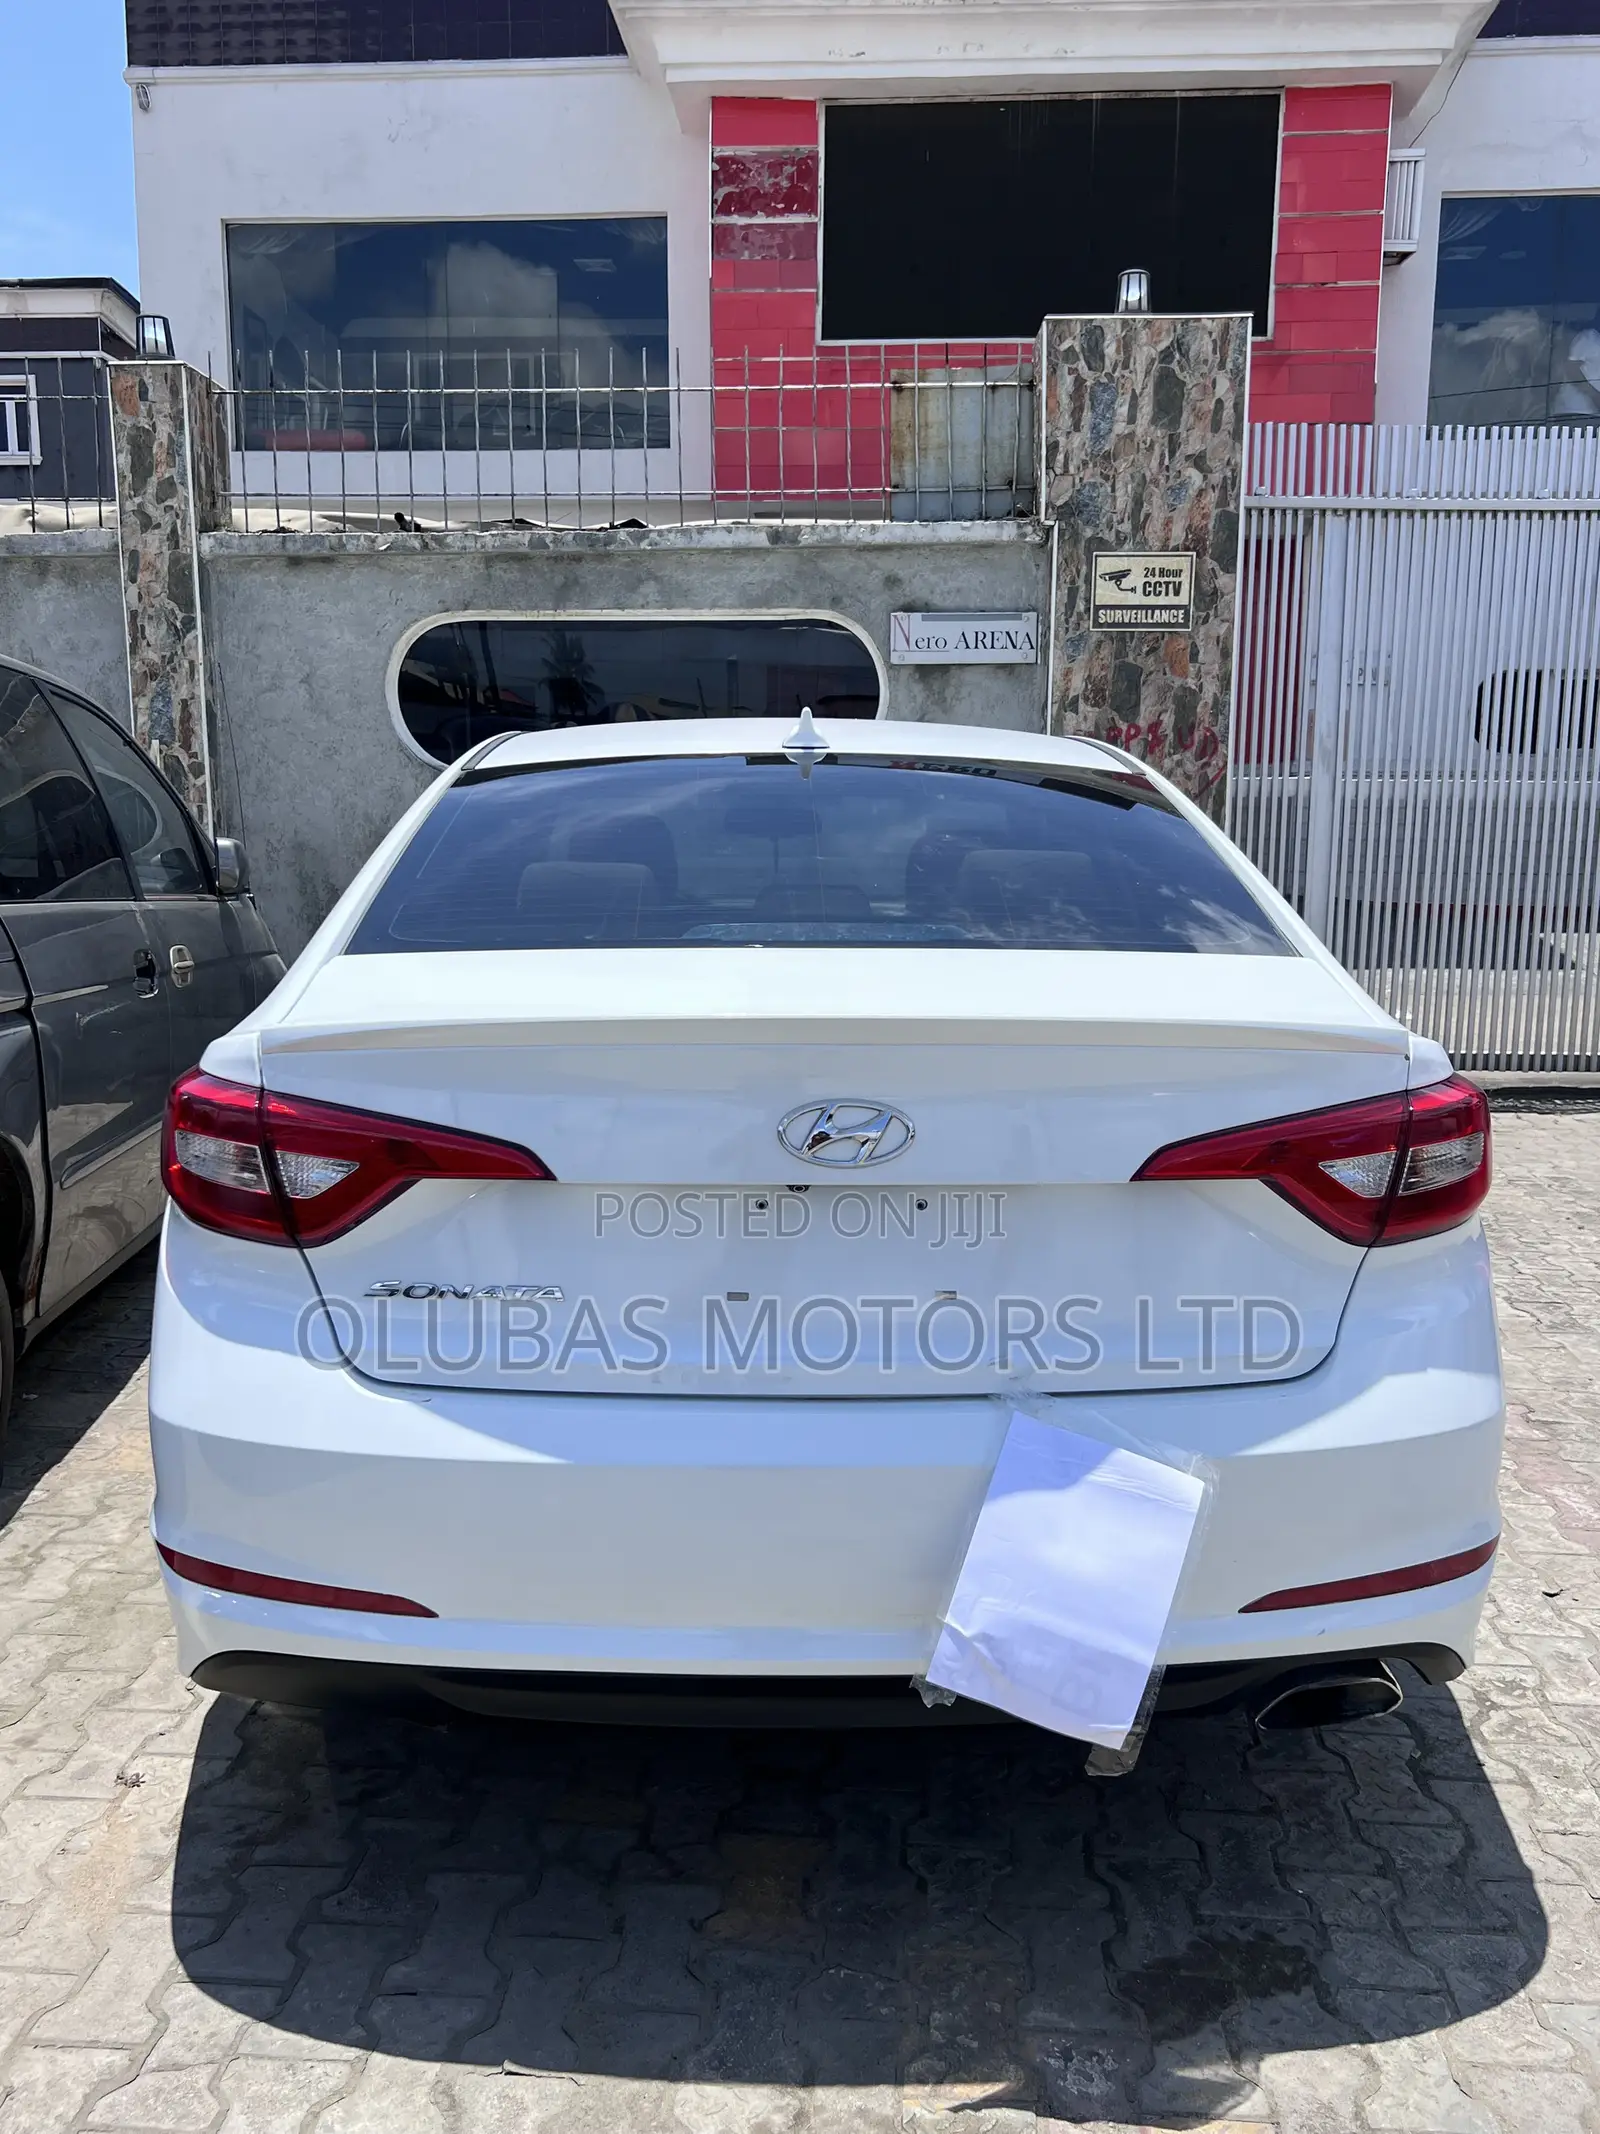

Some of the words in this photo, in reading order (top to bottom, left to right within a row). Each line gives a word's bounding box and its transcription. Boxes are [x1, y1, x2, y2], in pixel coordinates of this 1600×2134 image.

[1143, 567, 1157, 578] 24
[1158, 567, 1184, 579] Hour
[1142, 581, 1183, 597] CCTV
[1098, 609, 1185, 624] SURVEILLANCE
[892, 614, 948, 652] Nero
[954, 629, 1036, 651] ARENA
[363, 1280, 565, 1302] SONATA
